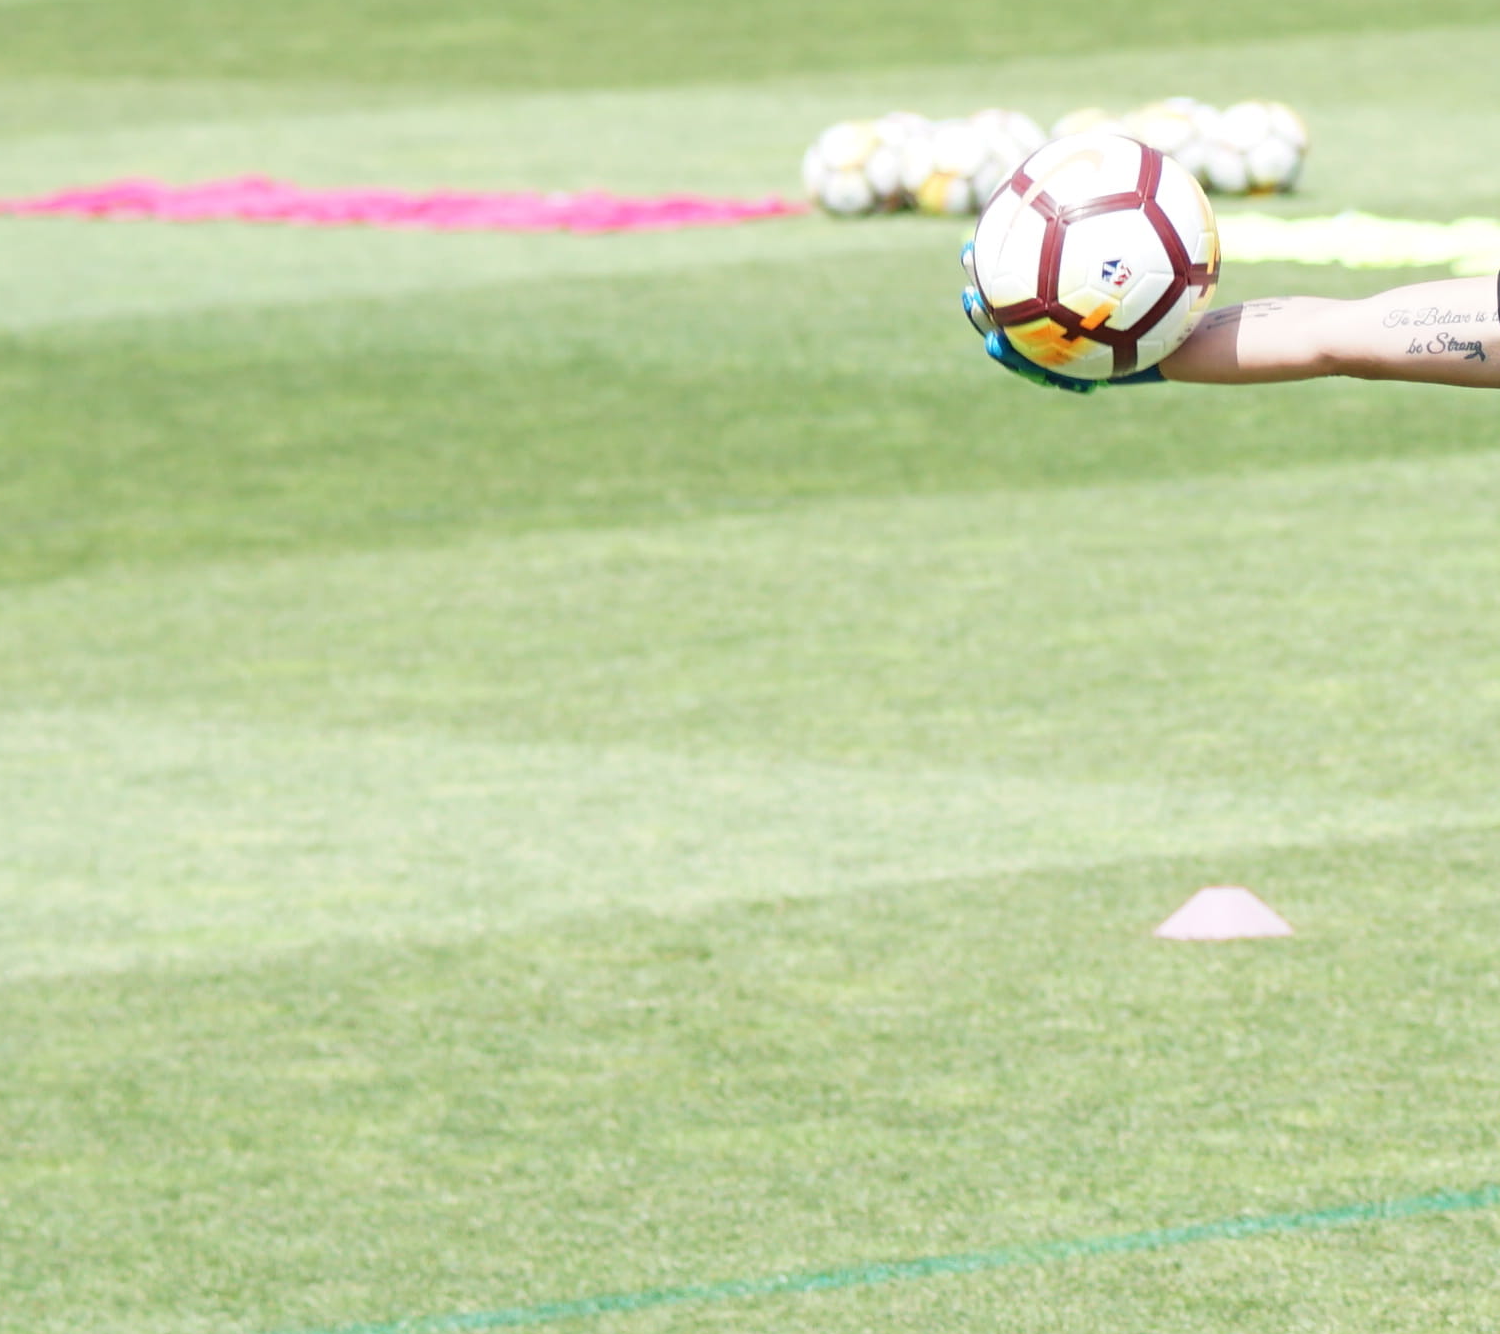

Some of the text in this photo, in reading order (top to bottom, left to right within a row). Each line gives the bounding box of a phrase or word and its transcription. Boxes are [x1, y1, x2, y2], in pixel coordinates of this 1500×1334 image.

[1475, 310, 1487, 323] is
[1405, 332, 1486, 362] be Strong
